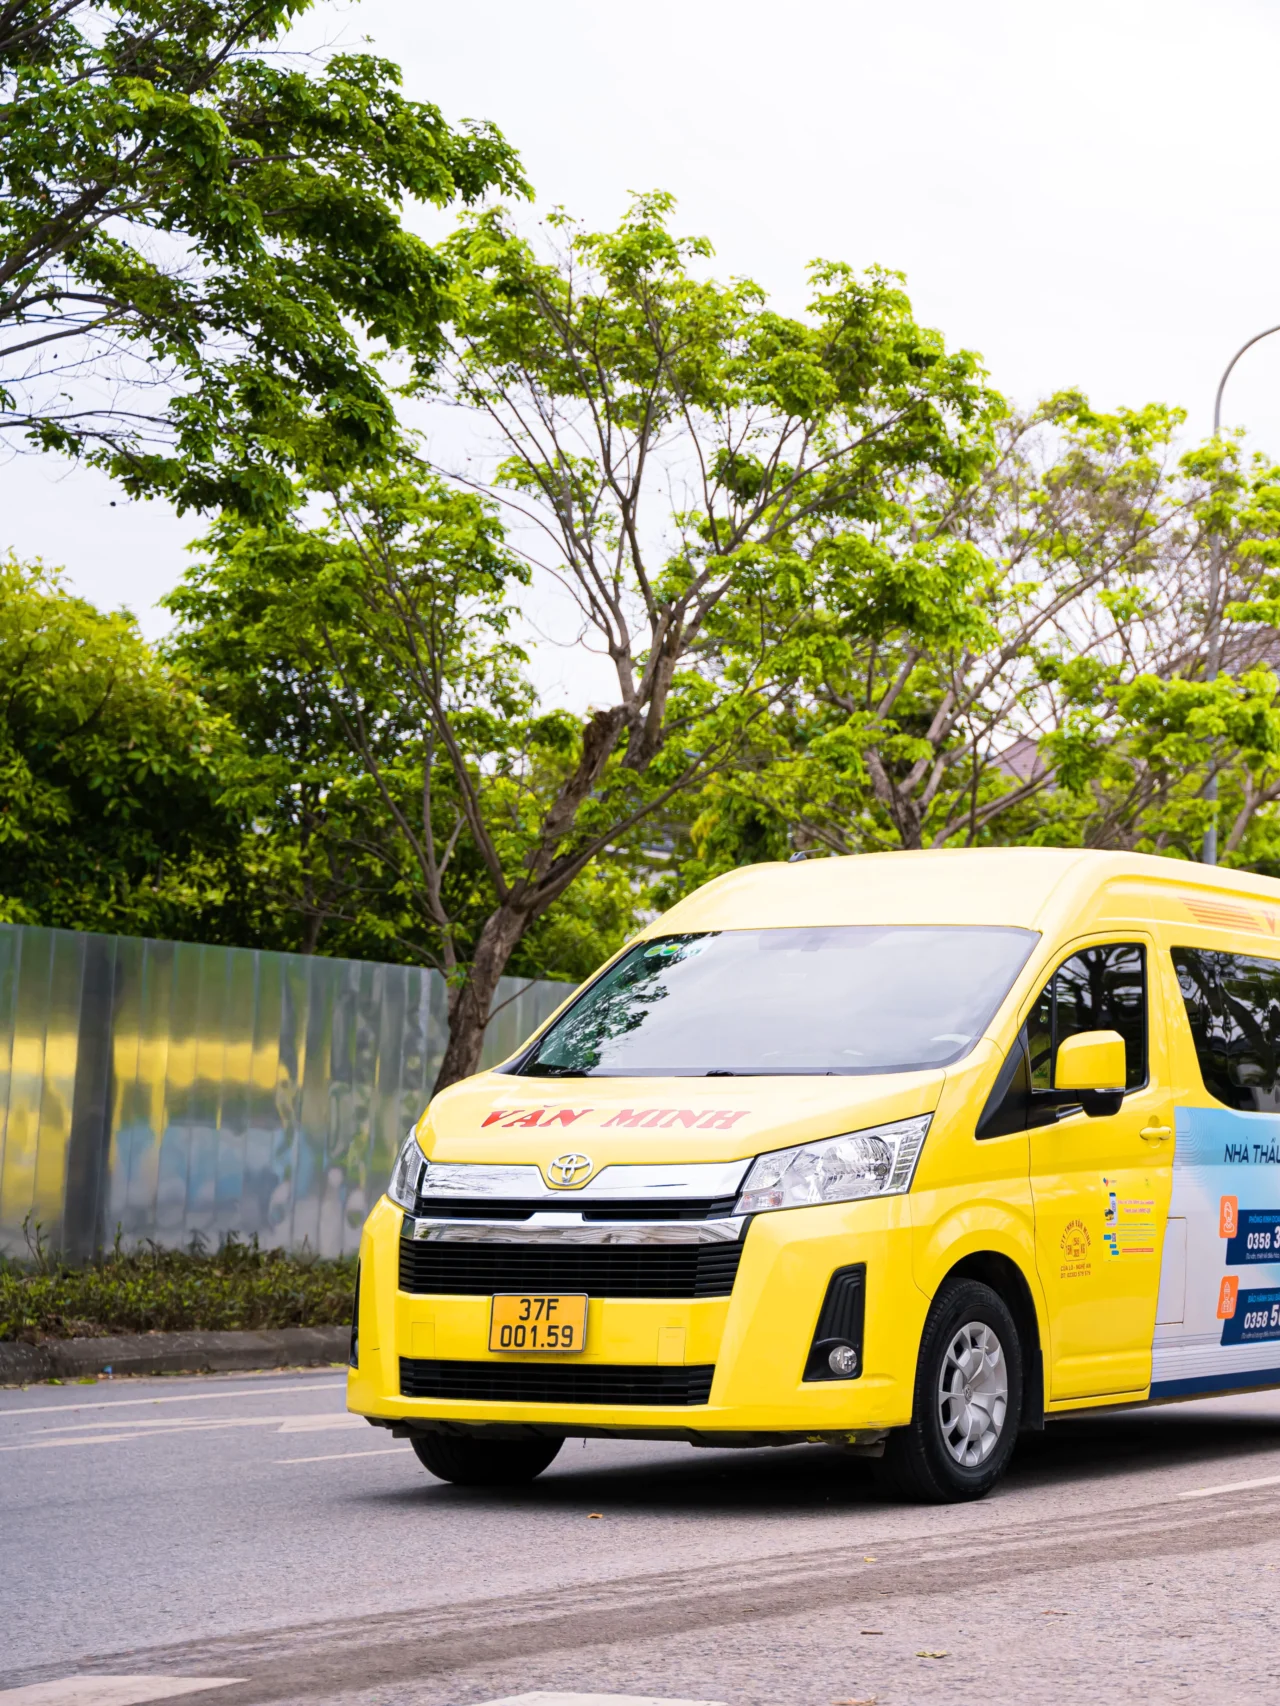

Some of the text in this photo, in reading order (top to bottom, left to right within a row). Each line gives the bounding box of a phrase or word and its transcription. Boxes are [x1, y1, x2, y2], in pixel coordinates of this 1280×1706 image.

[481, 1104, 752, 1130] VĂN MINH
[1224, 1136, 1249, 1163] NHÀ
[1247, 1232, 1271, 1249] 0358
[519, 1298, 559, 1321] 37F
[1244, 1311, 1268, 1329] 0358
[500, 1325, 573, 1347] 001.59
